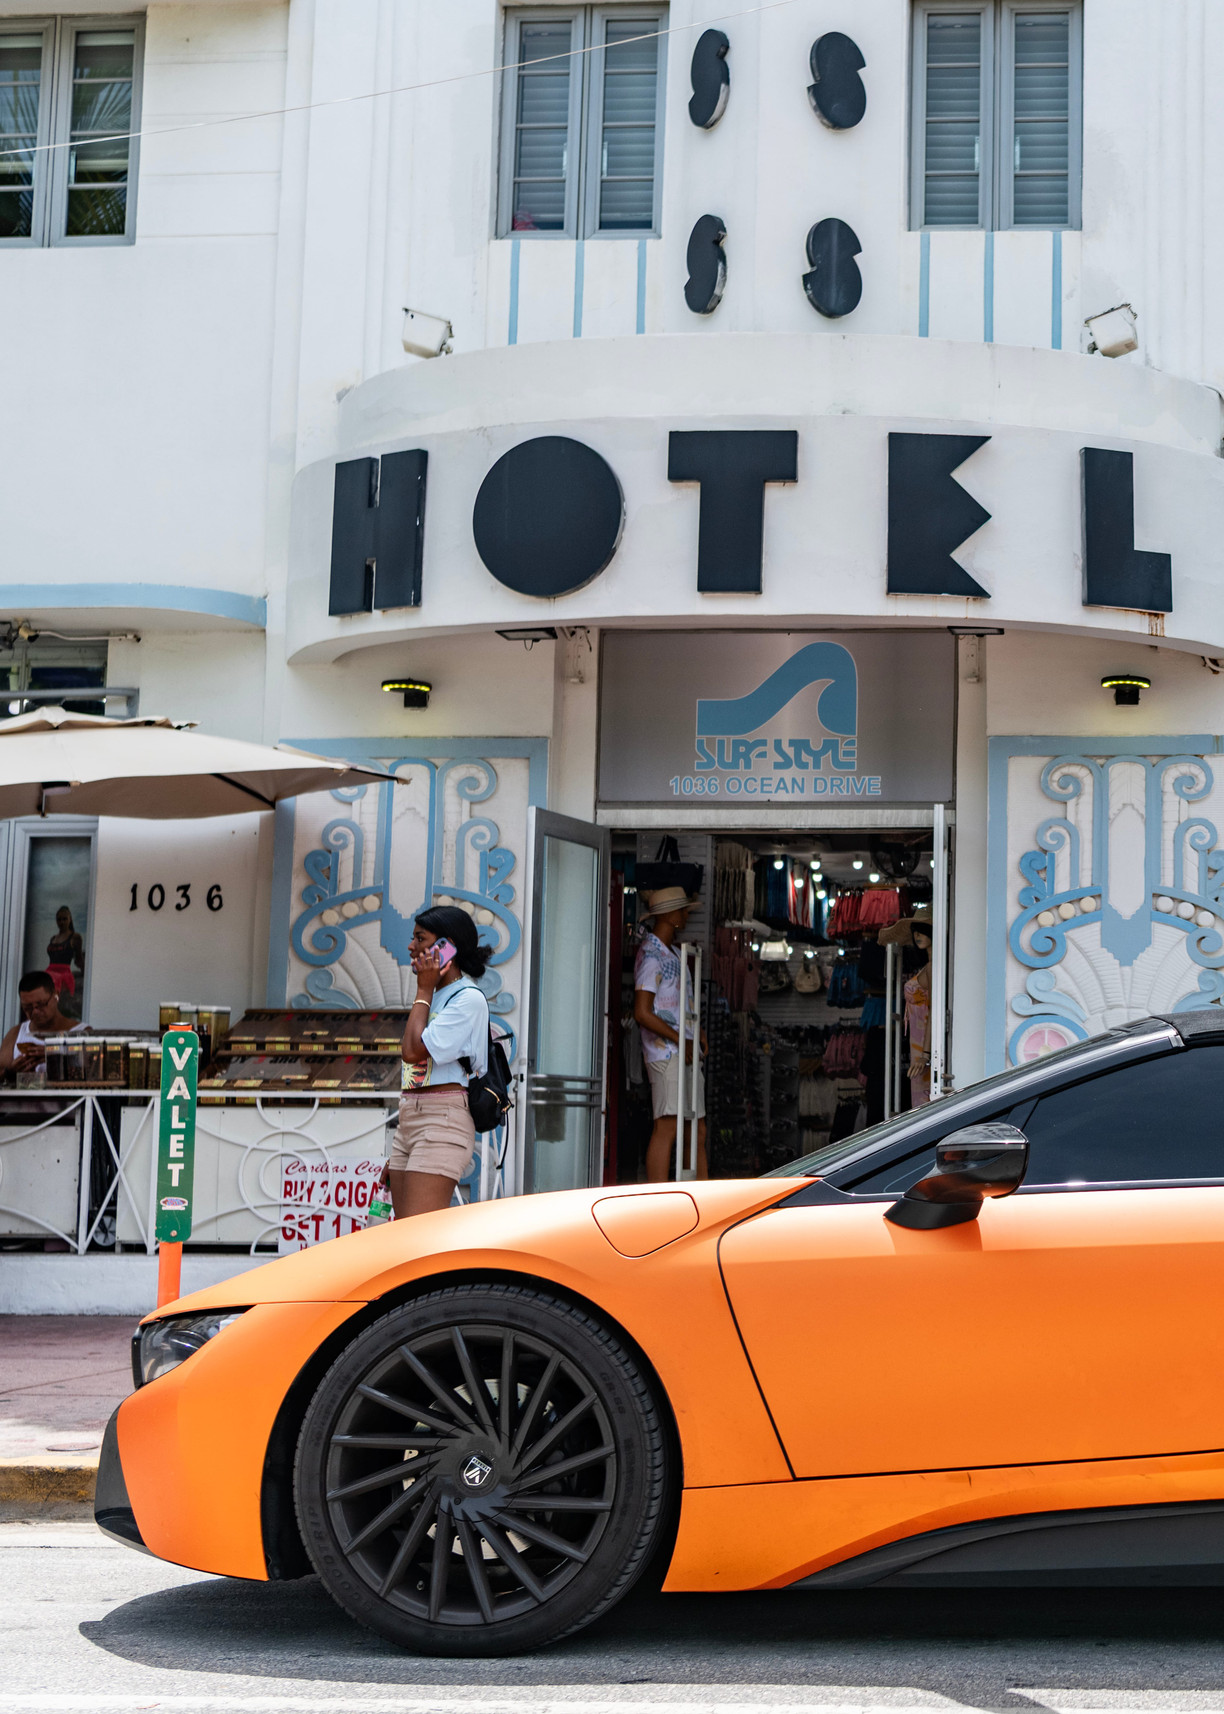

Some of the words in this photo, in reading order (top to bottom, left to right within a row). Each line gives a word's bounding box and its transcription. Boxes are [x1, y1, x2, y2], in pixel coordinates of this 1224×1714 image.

[329, 429, 1173, 617] HOTEL
[695, 737, 768, 771] SURF
[772, 737, 857, 771] STYLE
[669, 776, 719, 796] 1036
[725, 776, 806, 795] OCEAN
[812, 776, 882, 796] DRIVE
[129, 883, 223, 912] 1036
[166, 1047, 193, 1187] VALET
[283, 1180, 316, 1206] BUY
[281, 1213, 325, 1242] GET
